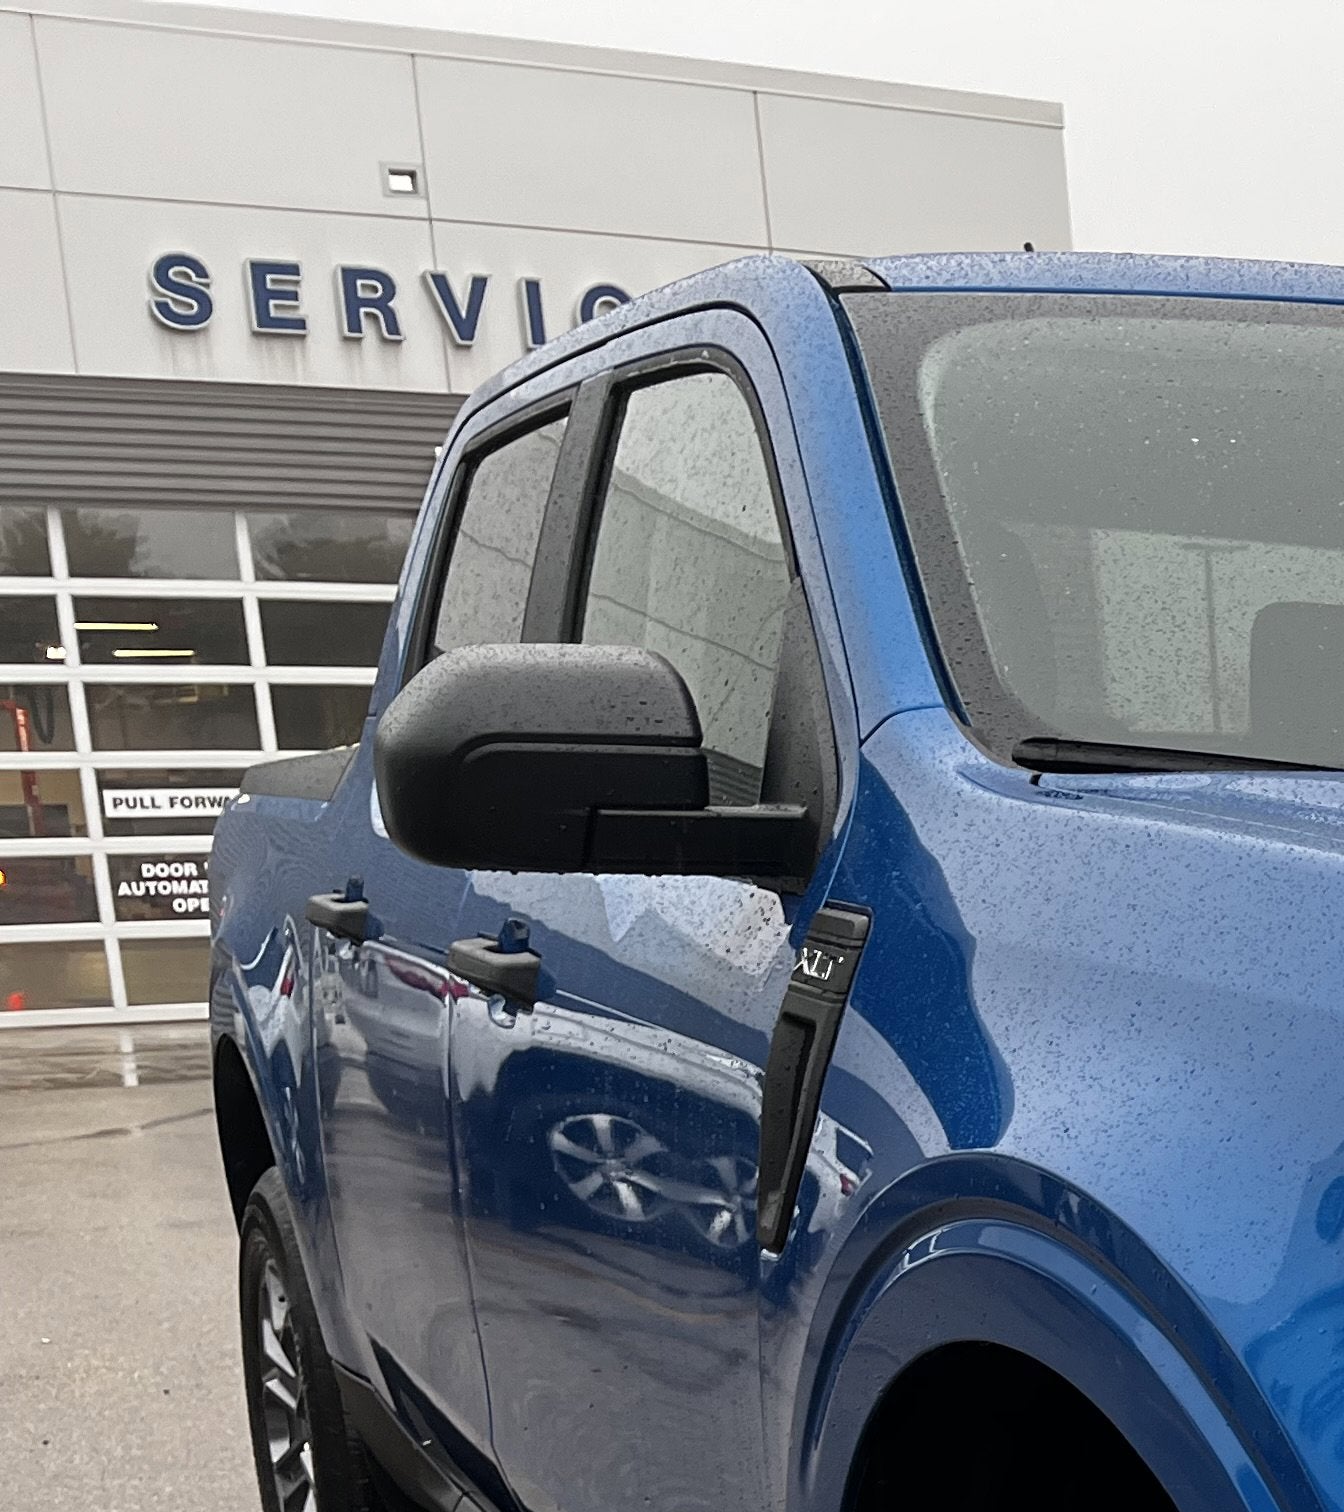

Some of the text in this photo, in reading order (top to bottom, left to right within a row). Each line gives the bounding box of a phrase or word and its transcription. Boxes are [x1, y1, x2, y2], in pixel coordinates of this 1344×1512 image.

[112, 796, 161, 810] PULL
[141, 862, 198, 878] DOOR
[792, 946, 846, 981] XLT
